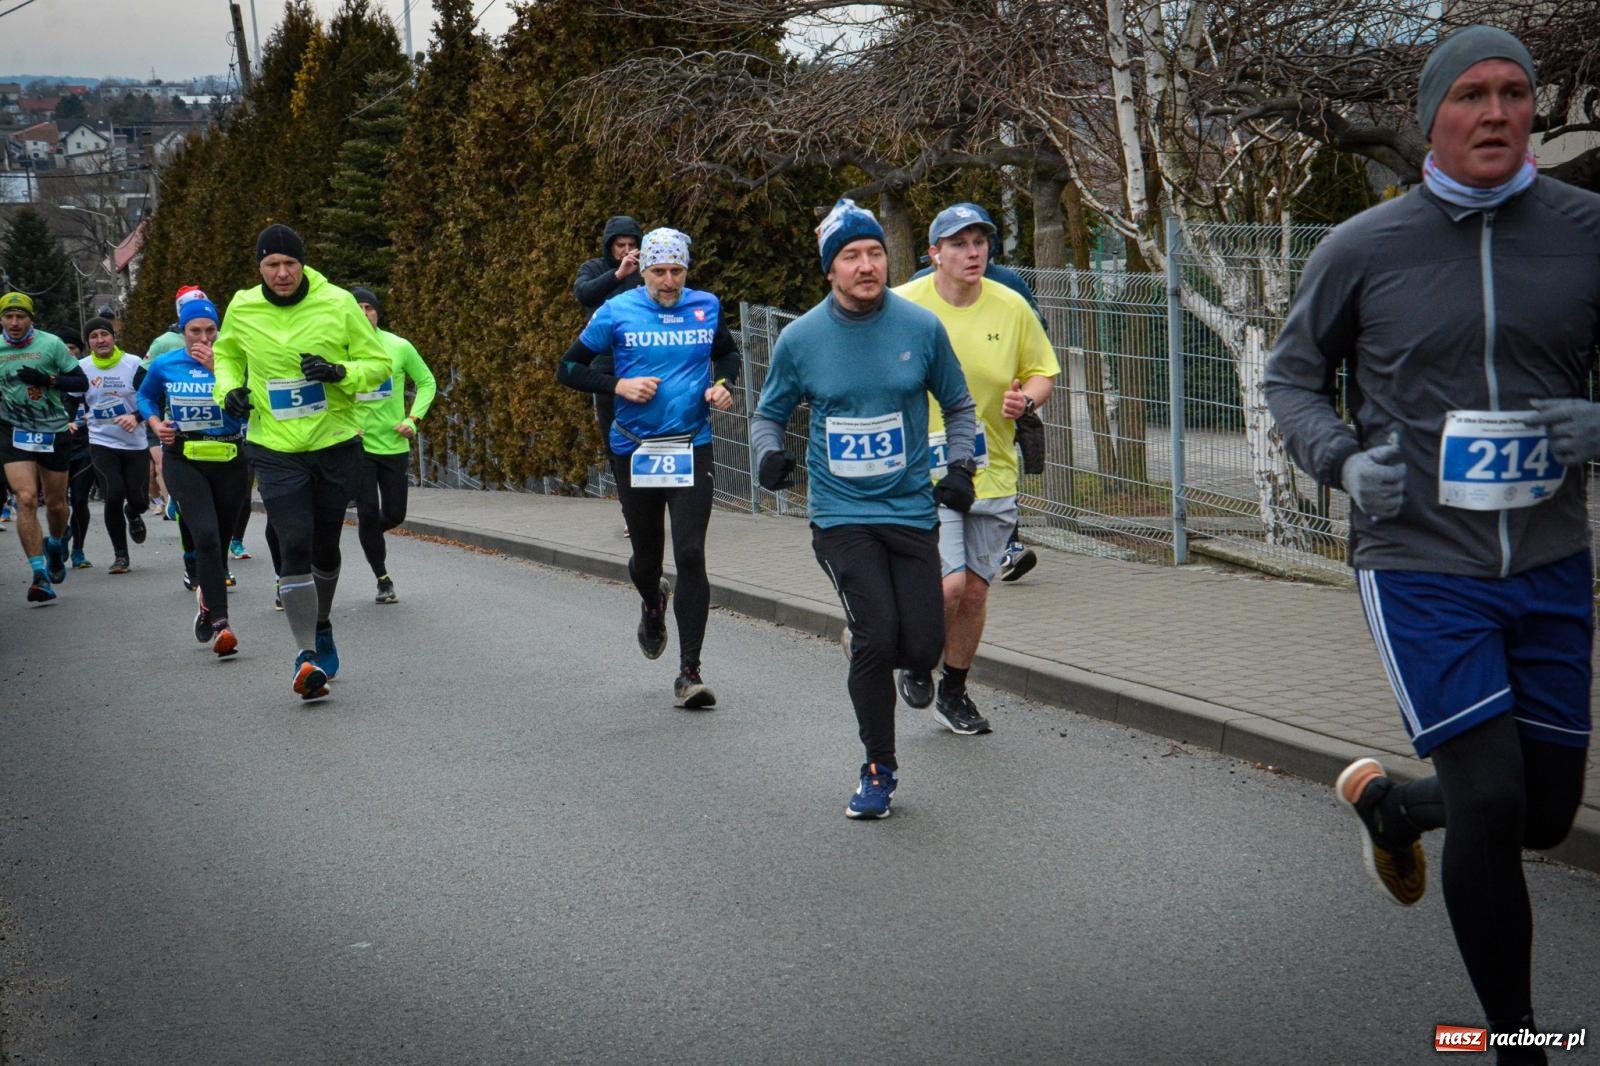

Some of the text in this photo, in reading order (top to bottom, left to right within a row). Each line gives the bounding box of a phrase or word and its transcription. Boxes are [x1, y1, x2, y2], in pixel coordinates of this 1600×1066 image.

[624, 328, 714, 347] RUNNERS
[290, 389, 303, 406] 5
[101, 409, 117, 419] 41
[180, 406, 213, 421] 125
[26, 432, 43, 444] 18
[840, 432, 893, 459] 213
[649, 455, 676, 474] 78
[1465, 439, 1549, 480] 214
